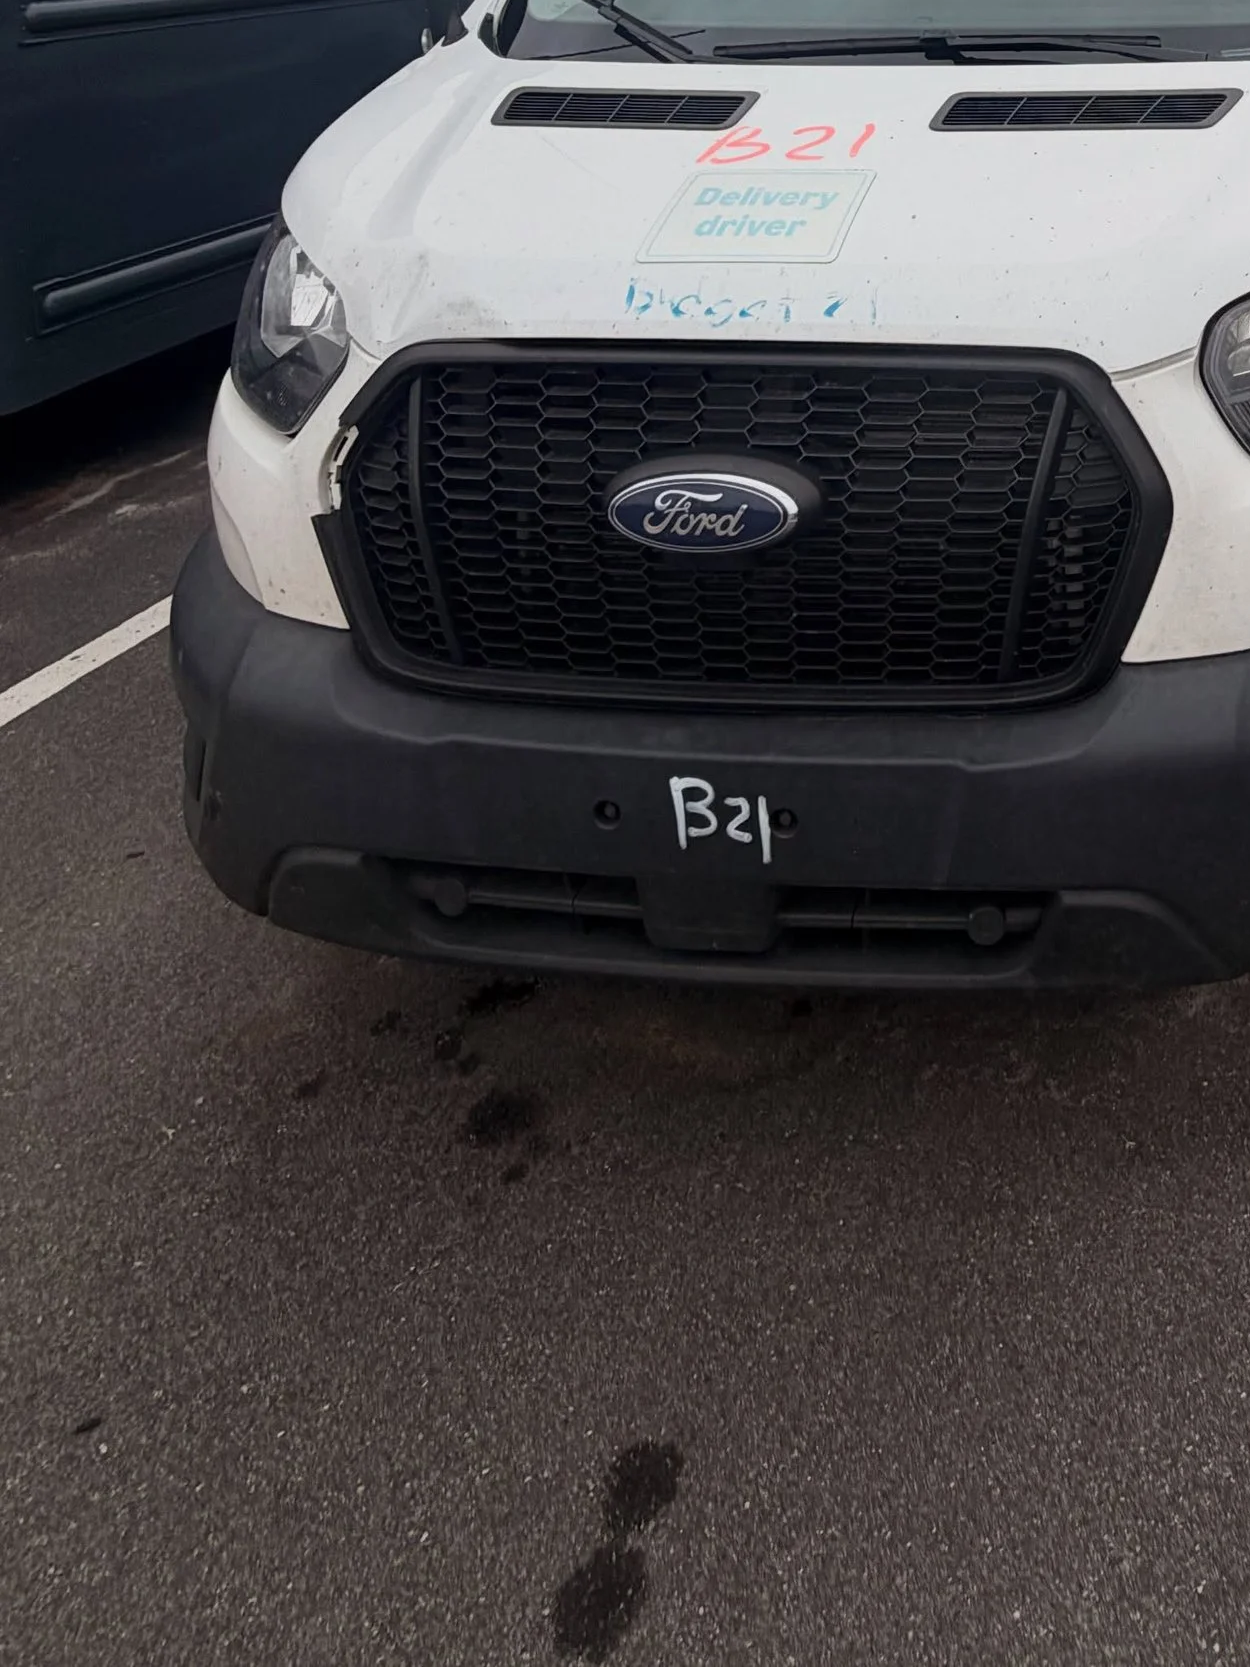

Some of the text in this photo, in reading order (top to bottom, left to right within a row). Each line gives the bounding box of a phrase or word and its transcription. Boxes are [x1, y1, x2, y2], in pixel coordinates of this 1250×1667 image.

[694, 186, 840, 210] Delivery
[694, 213, 808, 237] driver
[643, 489, 749, 539] Ford
[669, 776, 772, 864] B21
